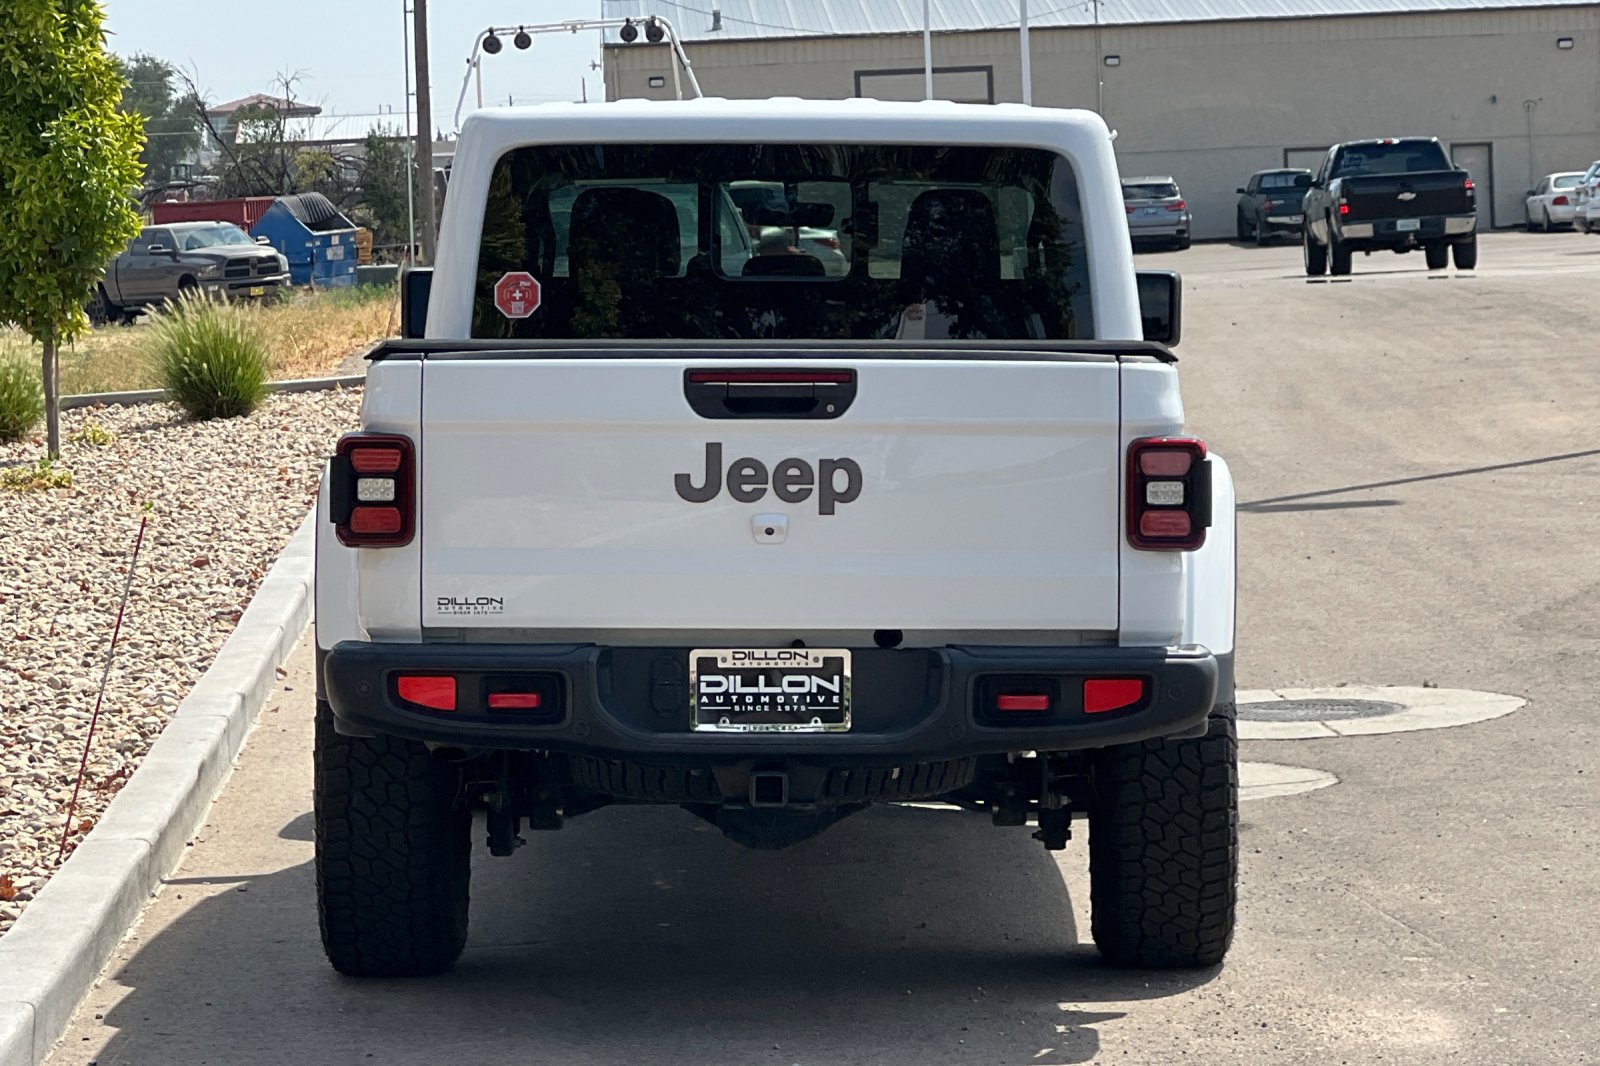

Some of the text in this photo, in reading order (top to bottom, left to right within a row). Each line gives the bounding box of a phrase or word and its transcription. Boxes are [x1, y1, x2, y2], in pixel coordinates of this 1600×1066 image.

[674, 442, 863, 516] Jeep
[437, 597, 504, 606] DILLON
[732, 651, 809, 661] DILLON
[700, 675, 840, 693] DILLON
[700, 695, 840, 703] AUTOMOTIVE
